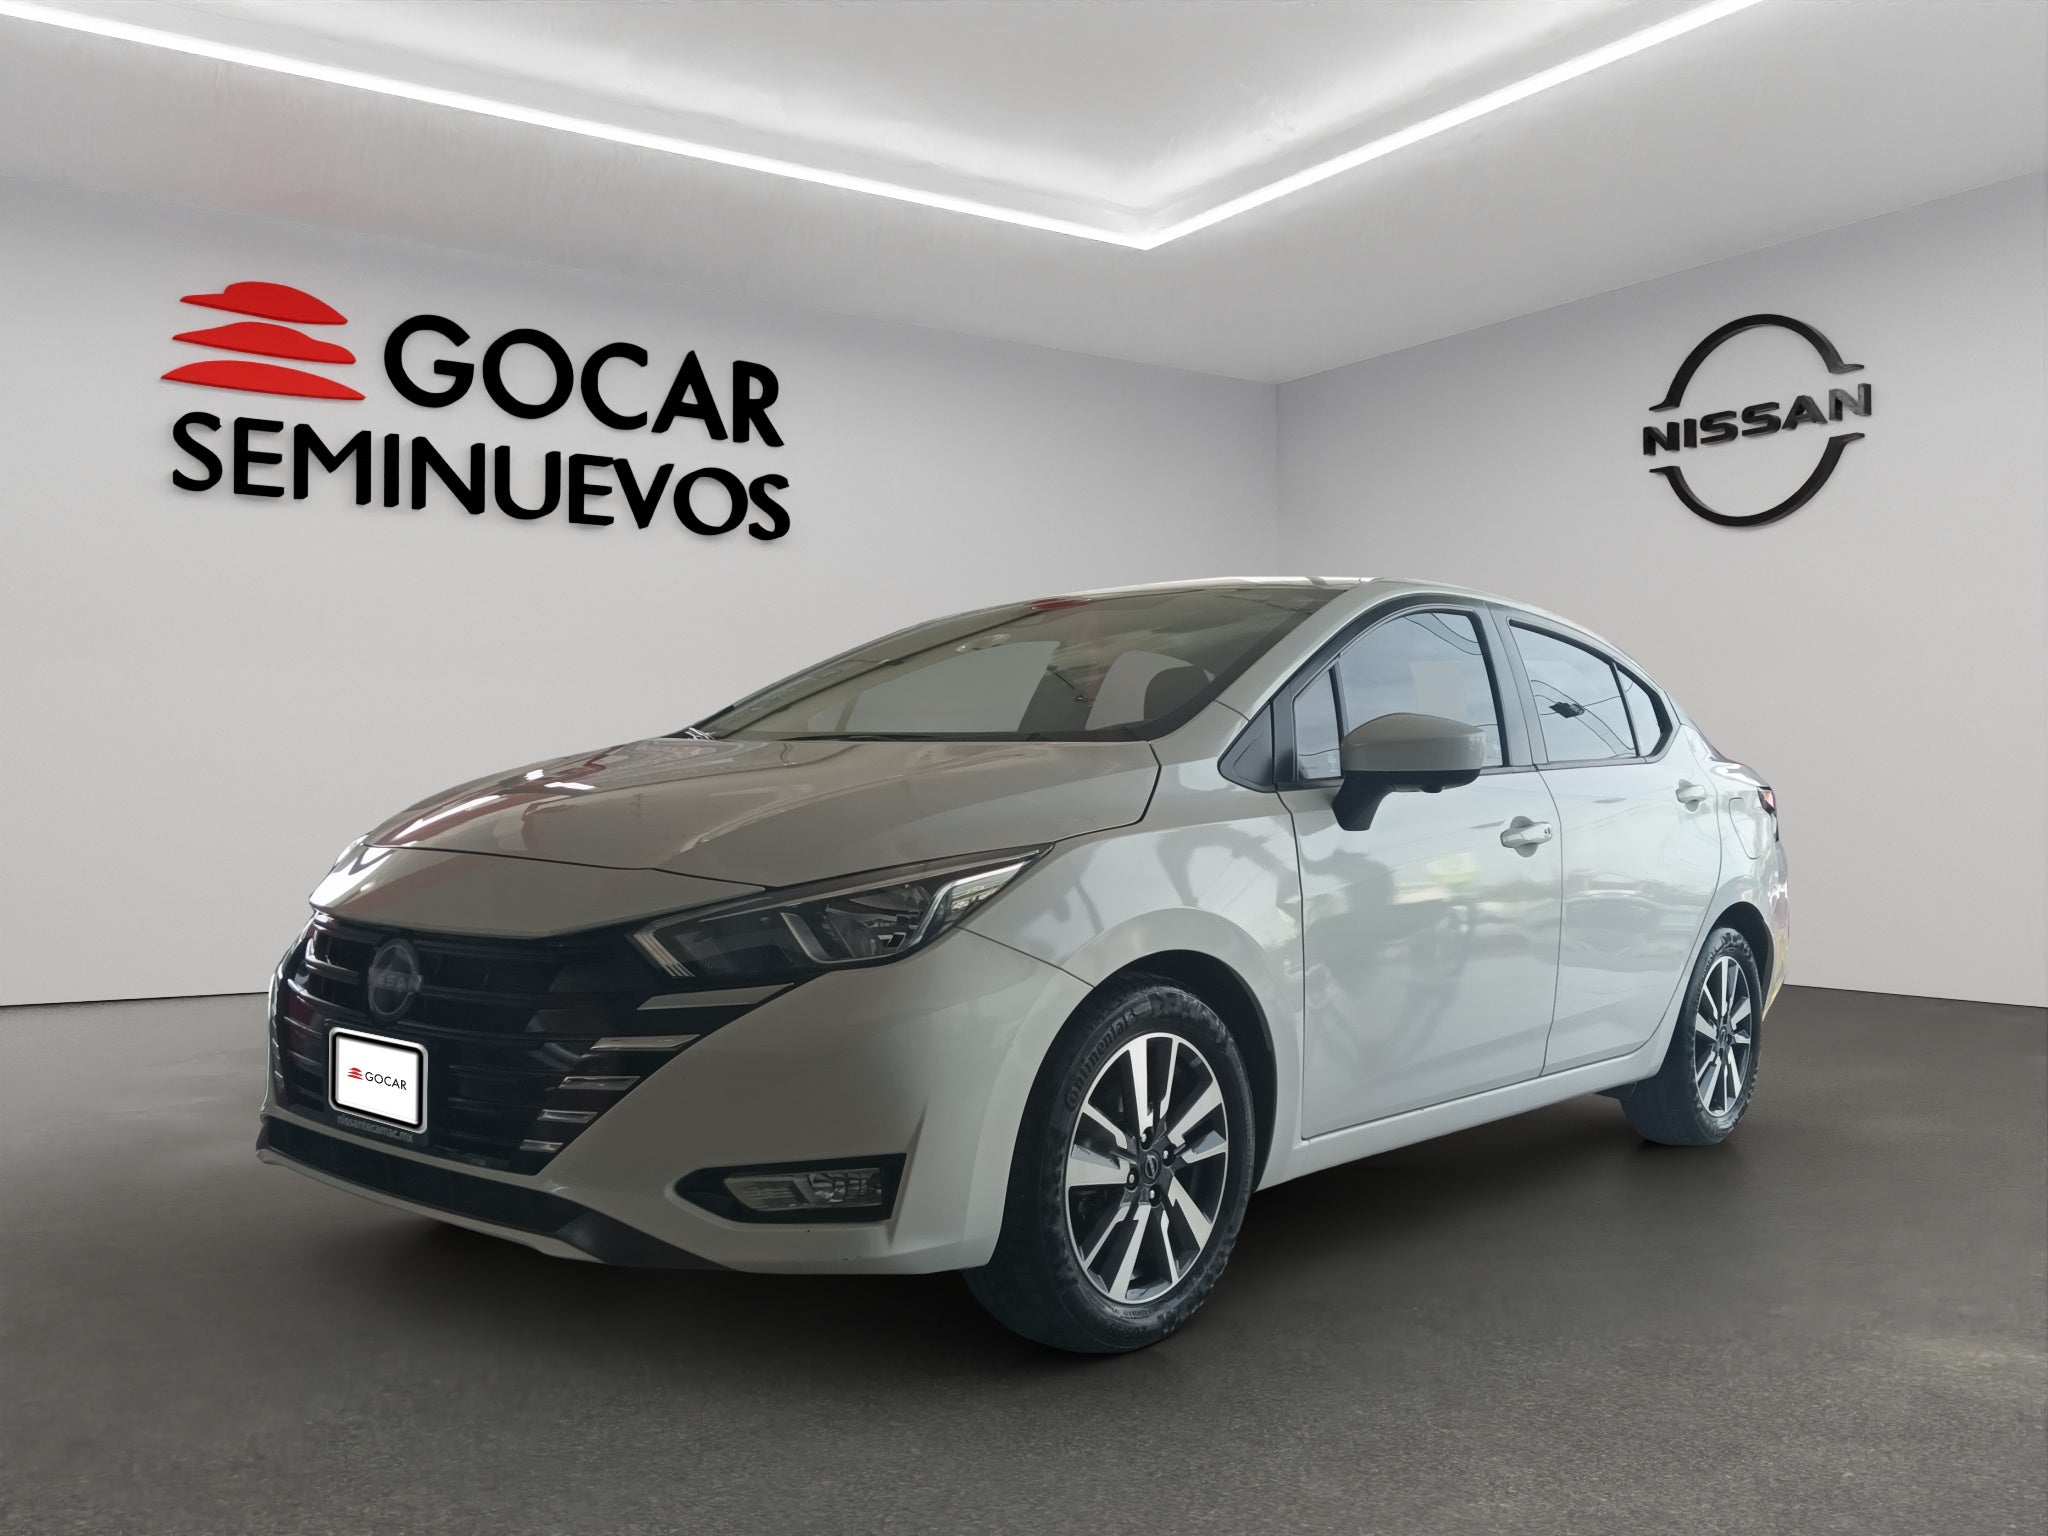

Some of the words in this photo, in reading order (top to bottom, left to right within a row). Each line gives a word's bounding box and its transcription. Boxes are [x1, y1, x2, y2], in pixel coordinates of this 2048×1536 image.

[384, 314, 784, 447] GOCAR
[1643, 383, 1872, 456] NISSAN
[172, 411, 791, 541] SEMINUEVOS
[365, 1071, 407, 1091] GOCAR
[1065, 1015, 1130, 1111] Continental
